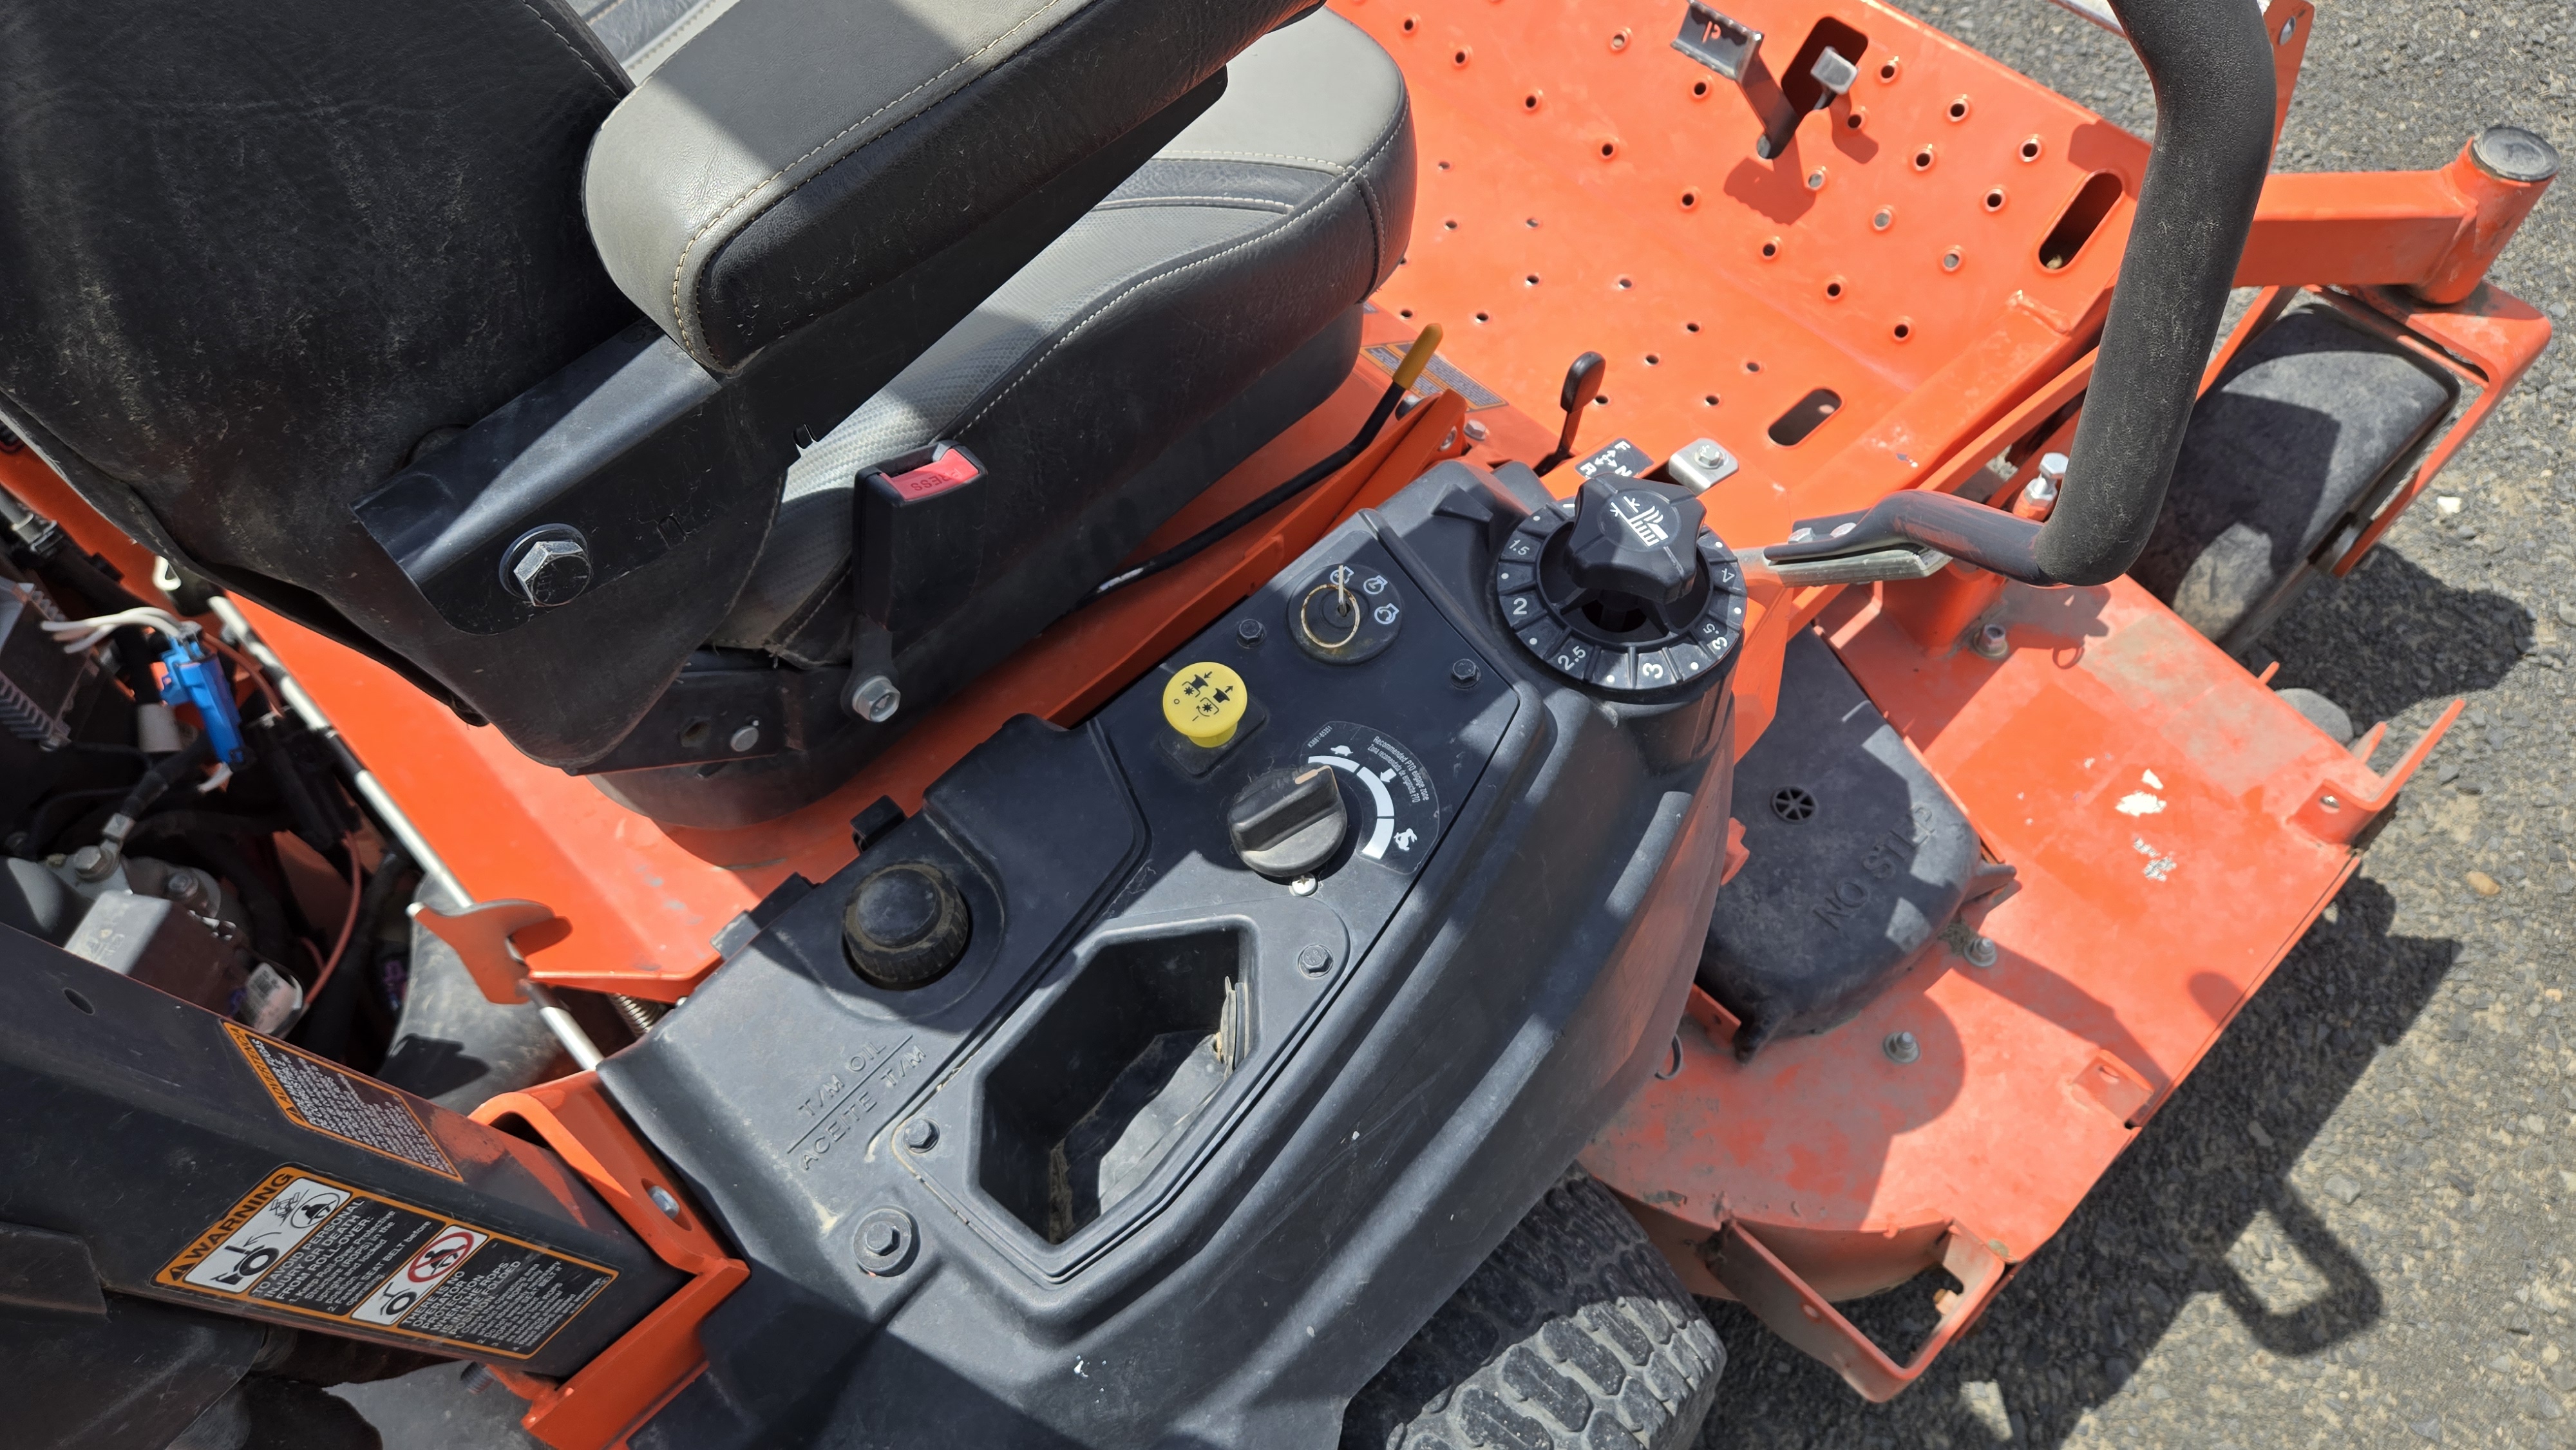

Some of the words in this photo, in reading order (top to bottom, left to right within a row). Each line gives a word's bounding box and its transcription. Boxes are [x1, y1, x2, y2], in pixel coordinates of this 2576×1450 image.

[1702, 21, 1721, 43] P
[1580, 462, 1597, 476] R
[1615, 440, 1631, 451] F
[1615, 465, 1633, 477] N
[910, 468, 963, 491] PRESS
[1509, 540, 1530, 556] 1.5
[1721, 568, 1736, 583] 4
[1513, 598, 1528, 615] 2
[1557, 645, 1587, 671] 2.5
[1703, 623, 1728, 650] 3.5
[1642, 663, 1663, 679] 3
[1367, 743, 1380, 755] Zona
[1378, 750, 1403, 772] recomendada
[1402, 775, 1416, 795] enganche
[1410, 793, 1421, 804] PTO
[1372, 735, 1409, 762] Recommended
[1404, 759, 1417, 771] PTO
[1411, 770, 1425, 789] engage
[1419, 787, 1430, 801] zone
[1812, 880, 1868, 932] NO
[1861, 806, 1936, 881] STEP
[231, 1028, 292, 1104] ADVERTENCIA
[251, 1038, 278, 1068] FUGAS
[798, 1074, 846, 1117] T/M
[849, 1042, 887, 1072] OIL
[272, 1066, 299, 1097] HABER
[274, 1058, 322, 1118] COMBUSTIBLE
[802, 1091, 878, 1171] ACEITE
[880, 1044, 927, 1086] T/M
[292, 1096, 319, 1125] PUEDE
[315, 1116, 333, 1131] DE
[184, 1173, 292, 1261] WARNING
[251, 1281, 274, 1294] TO
[267, 1250, 307, 1280] AVOID
[301, 1198, 365, 1250] PERSONAL
[262, 1263, 307, 1297] INJURY
[301, 1247, 325, 1262] OR
[319, 1214, 361, 1246] DEATH
[274, 1272, 312, 1299] FROM
[306, 1215, 374, 1271] ROLL-OVER:
[294, 1277, 321, 1296] Keep
[315, 1245, 357, 1277] Roll-Over
[352, 1210, 397, 1245] Protective
[303, 1267, 345, 1299] Structure
[339, 1241, 374, 1267] (ROPS)
[368, 1233, 383, 1241] in
[377, 1221, 397, 1234] the
[312, 1276, 347, 1301] upright
[341, 1262, 363, 1276] and
[357, 1238, 388, 1262] locked
[334, 1281, 366, 1304] Fasten
[360, 1261, 386, 1281] SEAT
[381, 1242, 408, 1261] BELT
[402, 1220, 432, 1243] before
[323, 1274, 361, 1304] position.
[343, 1272, 387, 1306] operating.
[401, 1295, 440, 1325] THERE
[434, 1285, 450, 1294] IS
[445, 1270, 466, 1284] NO
[410, 1279, 468, 1327] OPERATOR
[420, 1274, 485, 1329] PROTECTION
[430, 1304, 464, 1331] WHEN
[458, 1286, 483, 1304] THE
[478, 1261, 510, 1286] ROPS
[439, 1324, 455, 1333] IS
[450, 1313, 466, 1323] IN
[460, 1296, 484, 1313] THE
[480, 1260, 522, 1295] FOLDED
[448, 1293, 498, 1335] POSITION.
[460, 1315, 485, 1333] Check
[481, 1304, 497, 1314] the
[492, 1276, 527, 1304] operating
[522, 1263, 541, 1276] area
[468, 1322, 486, 1334] and
[482, 1312, 497, 1322] fold
[506, 1281, 529, 1300] ROPS
[525, 1268, 544, 1281] only
[476, 1319, 498, 1335] when
[494, 1290, 530, 1319] absolutely
[526, 1259, 564, 1290] necessary.
[483, 1328, 497, 1337] Do
[493, 1317, 508, 1328] not
[504, 1303, 524, 1317] wear
[519, 1286, 541, 1303] SEAT
[537, 1272, 557, 1286] BELT
[497, 1324, 519, 1340] Raise
[515, 1312, 531, 1324] and
[527, 1299, 545, 1312] lock
[540, 1281, 564, 1299] ROPS
[513, 1319, 533, 1334] soon
[529, 1311, 541, 1319] as
[537, 1290, 564, 1311] vertical
[560, 1302, 576, 1313] and
[490, 1321, 514, 1339] ROPS
[518, 1330, 538, 1344] Read
[534, 1313, 556, 1330] ROPS
